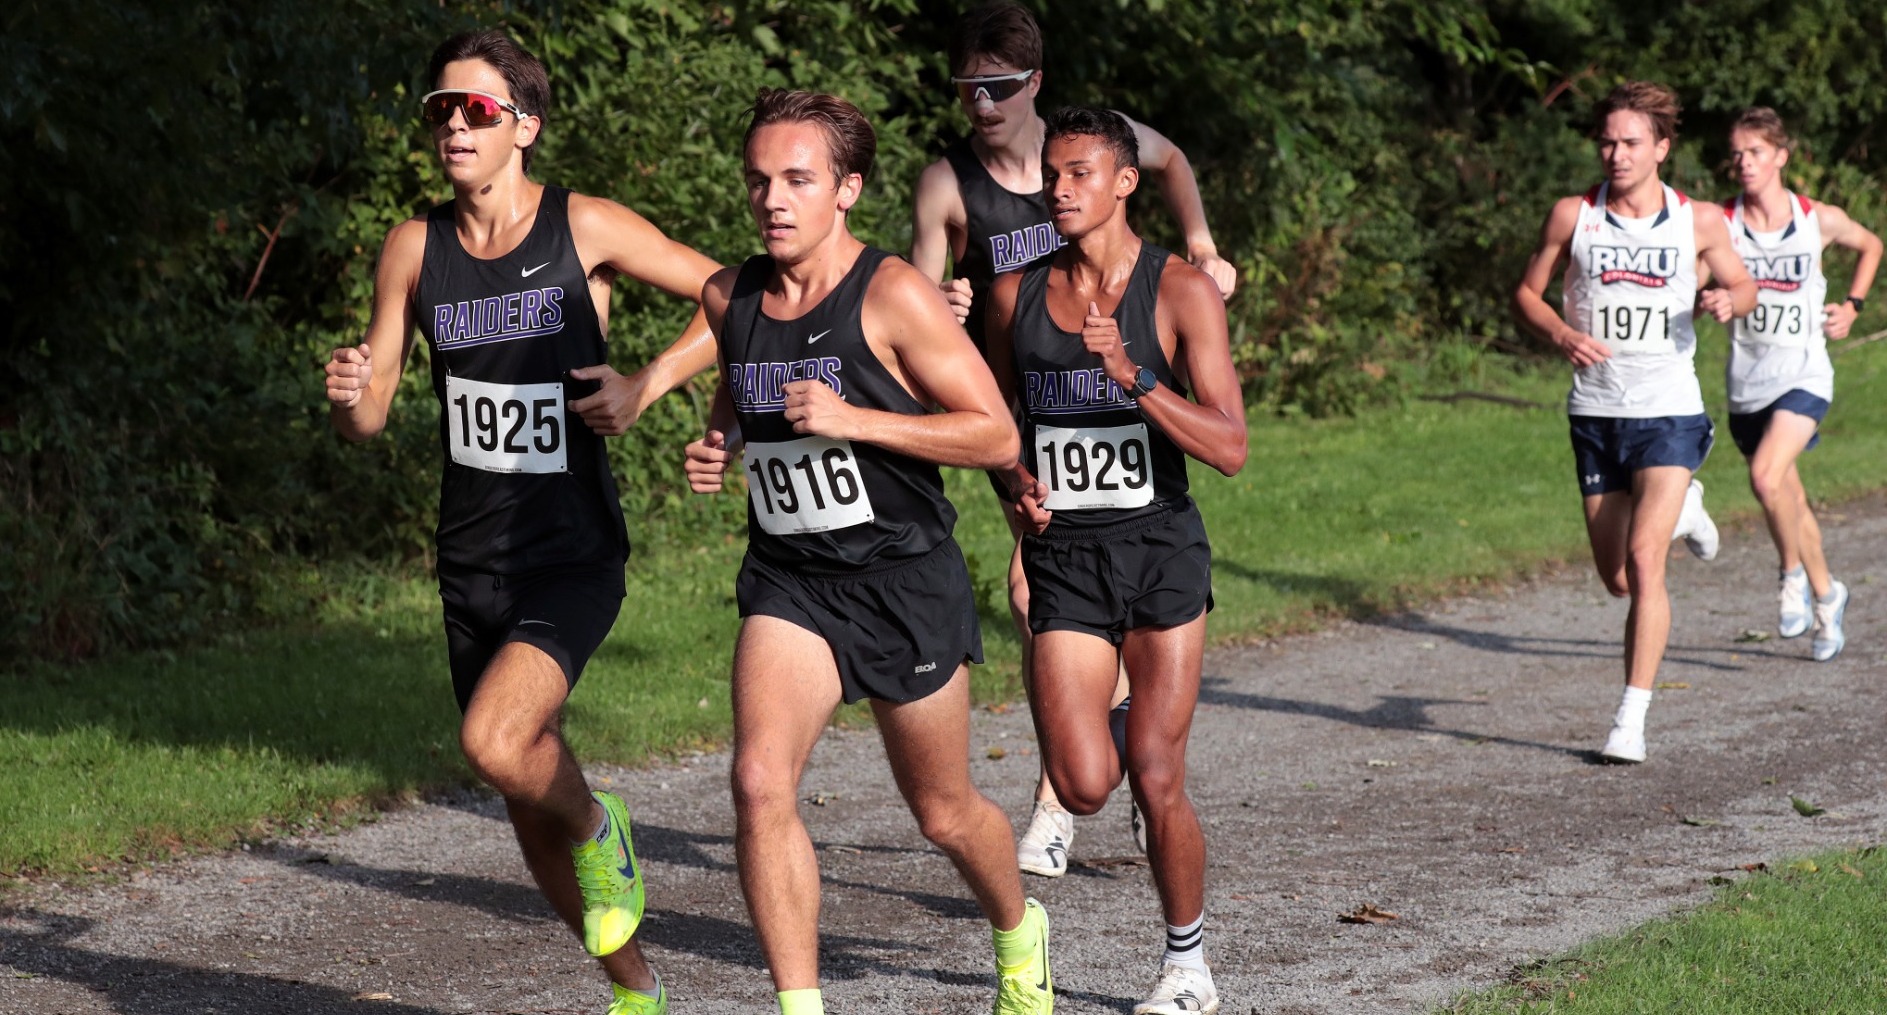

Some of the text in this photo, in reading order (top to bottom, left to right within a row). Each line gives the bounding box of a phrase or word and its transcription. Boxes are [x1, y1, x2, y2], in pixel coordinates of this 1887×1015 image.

[1589, 245, 1679, 279] RMU
[434, 286, 565, 344] RAIDERS
[1599, 305, 1669, 340] 1971
[1024, 366, 1142, 407] RAIDER
[454, 394, 560, 454] 1925
[749, 448, 859, 515] 1916
[1042, 438, 1148, 492] 1929
